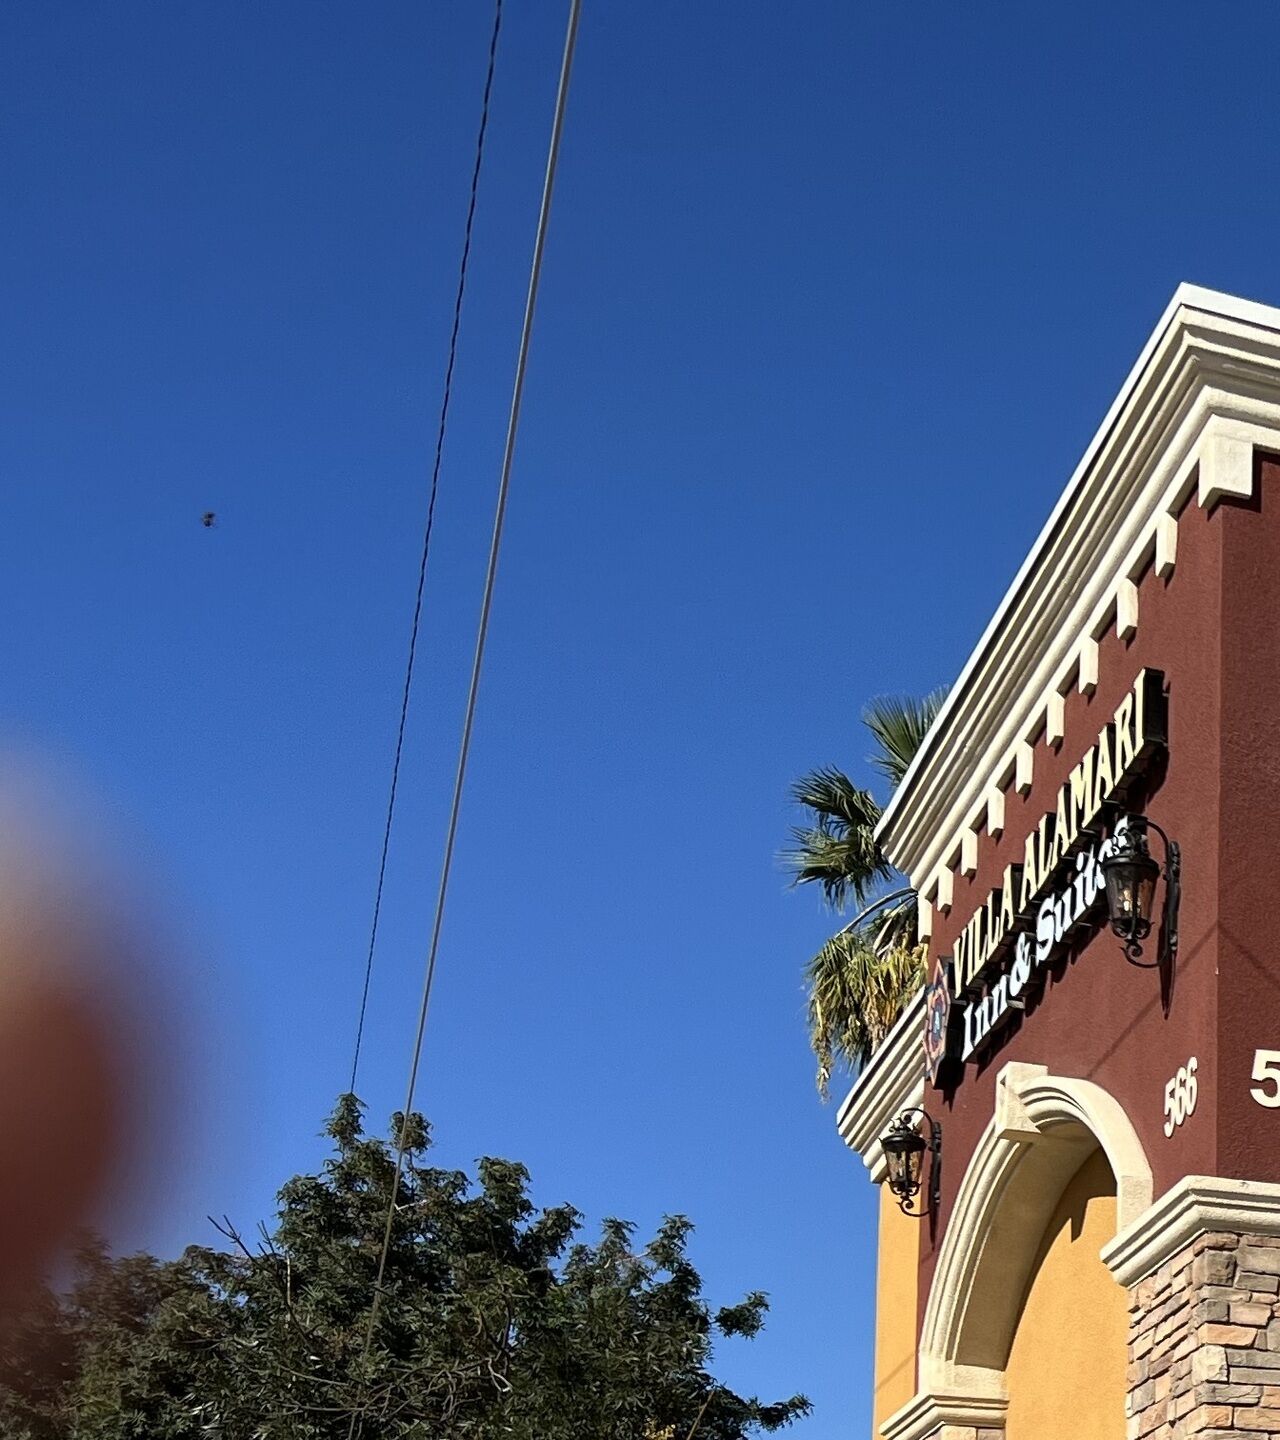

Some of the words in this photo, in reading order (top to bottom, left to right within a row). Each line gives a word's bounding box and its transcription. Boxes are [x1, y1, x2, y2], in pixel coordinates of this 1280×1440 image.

[953, 863, 1015, 1000] VILLA
[1018, 667, 1147, 914] ALAMARI
[961, 974, 1009, 1062] Inn
[1009, 931, 1031, 998] &
[1163, 1056, 1198, 1138] 566
